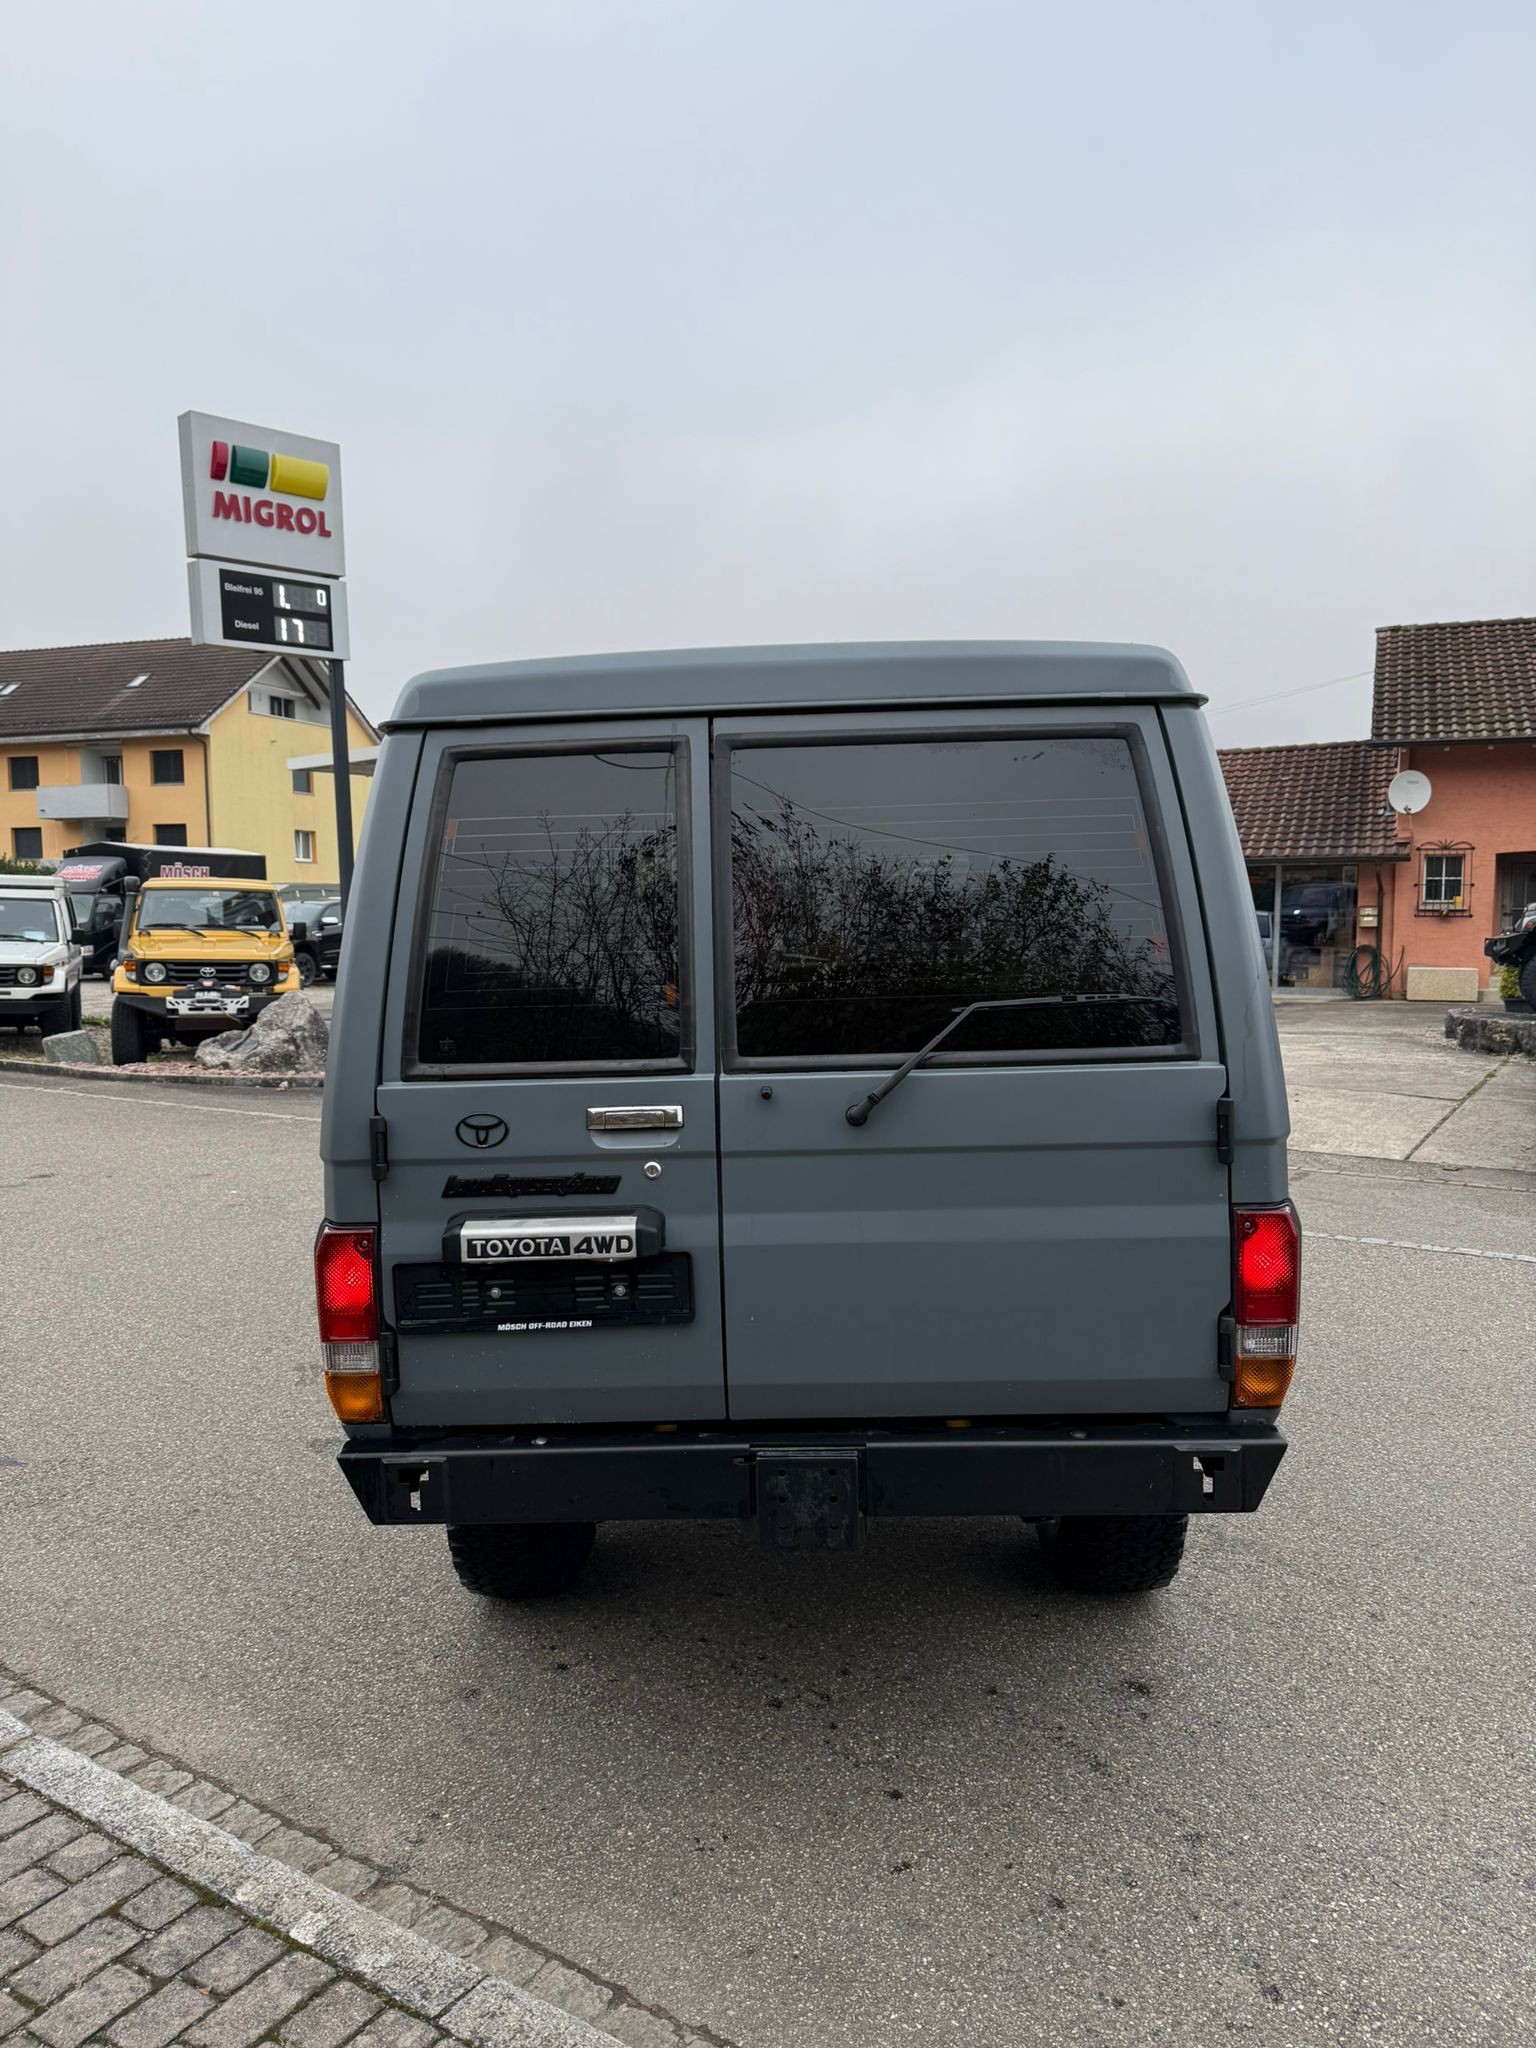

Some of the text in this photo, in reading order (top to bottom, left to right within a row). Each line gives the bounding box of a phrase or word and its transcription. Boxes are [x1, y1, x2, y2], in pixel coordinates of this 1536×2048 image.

[212, 490, 332, 538] MIGROL
[224, 582, 253, 595] Bleifrei
[253, 587, 264, 596] 95
[234, 619, 260, 631] Diesel
[160, 862, 210, 878] MÖSCH
[472, 1235, 634, 1257] TOYOTA 4WD
[528, 1320, 568, 1330] OFF-ROAD
[569, 1319, 593, 1328] EIKEN
